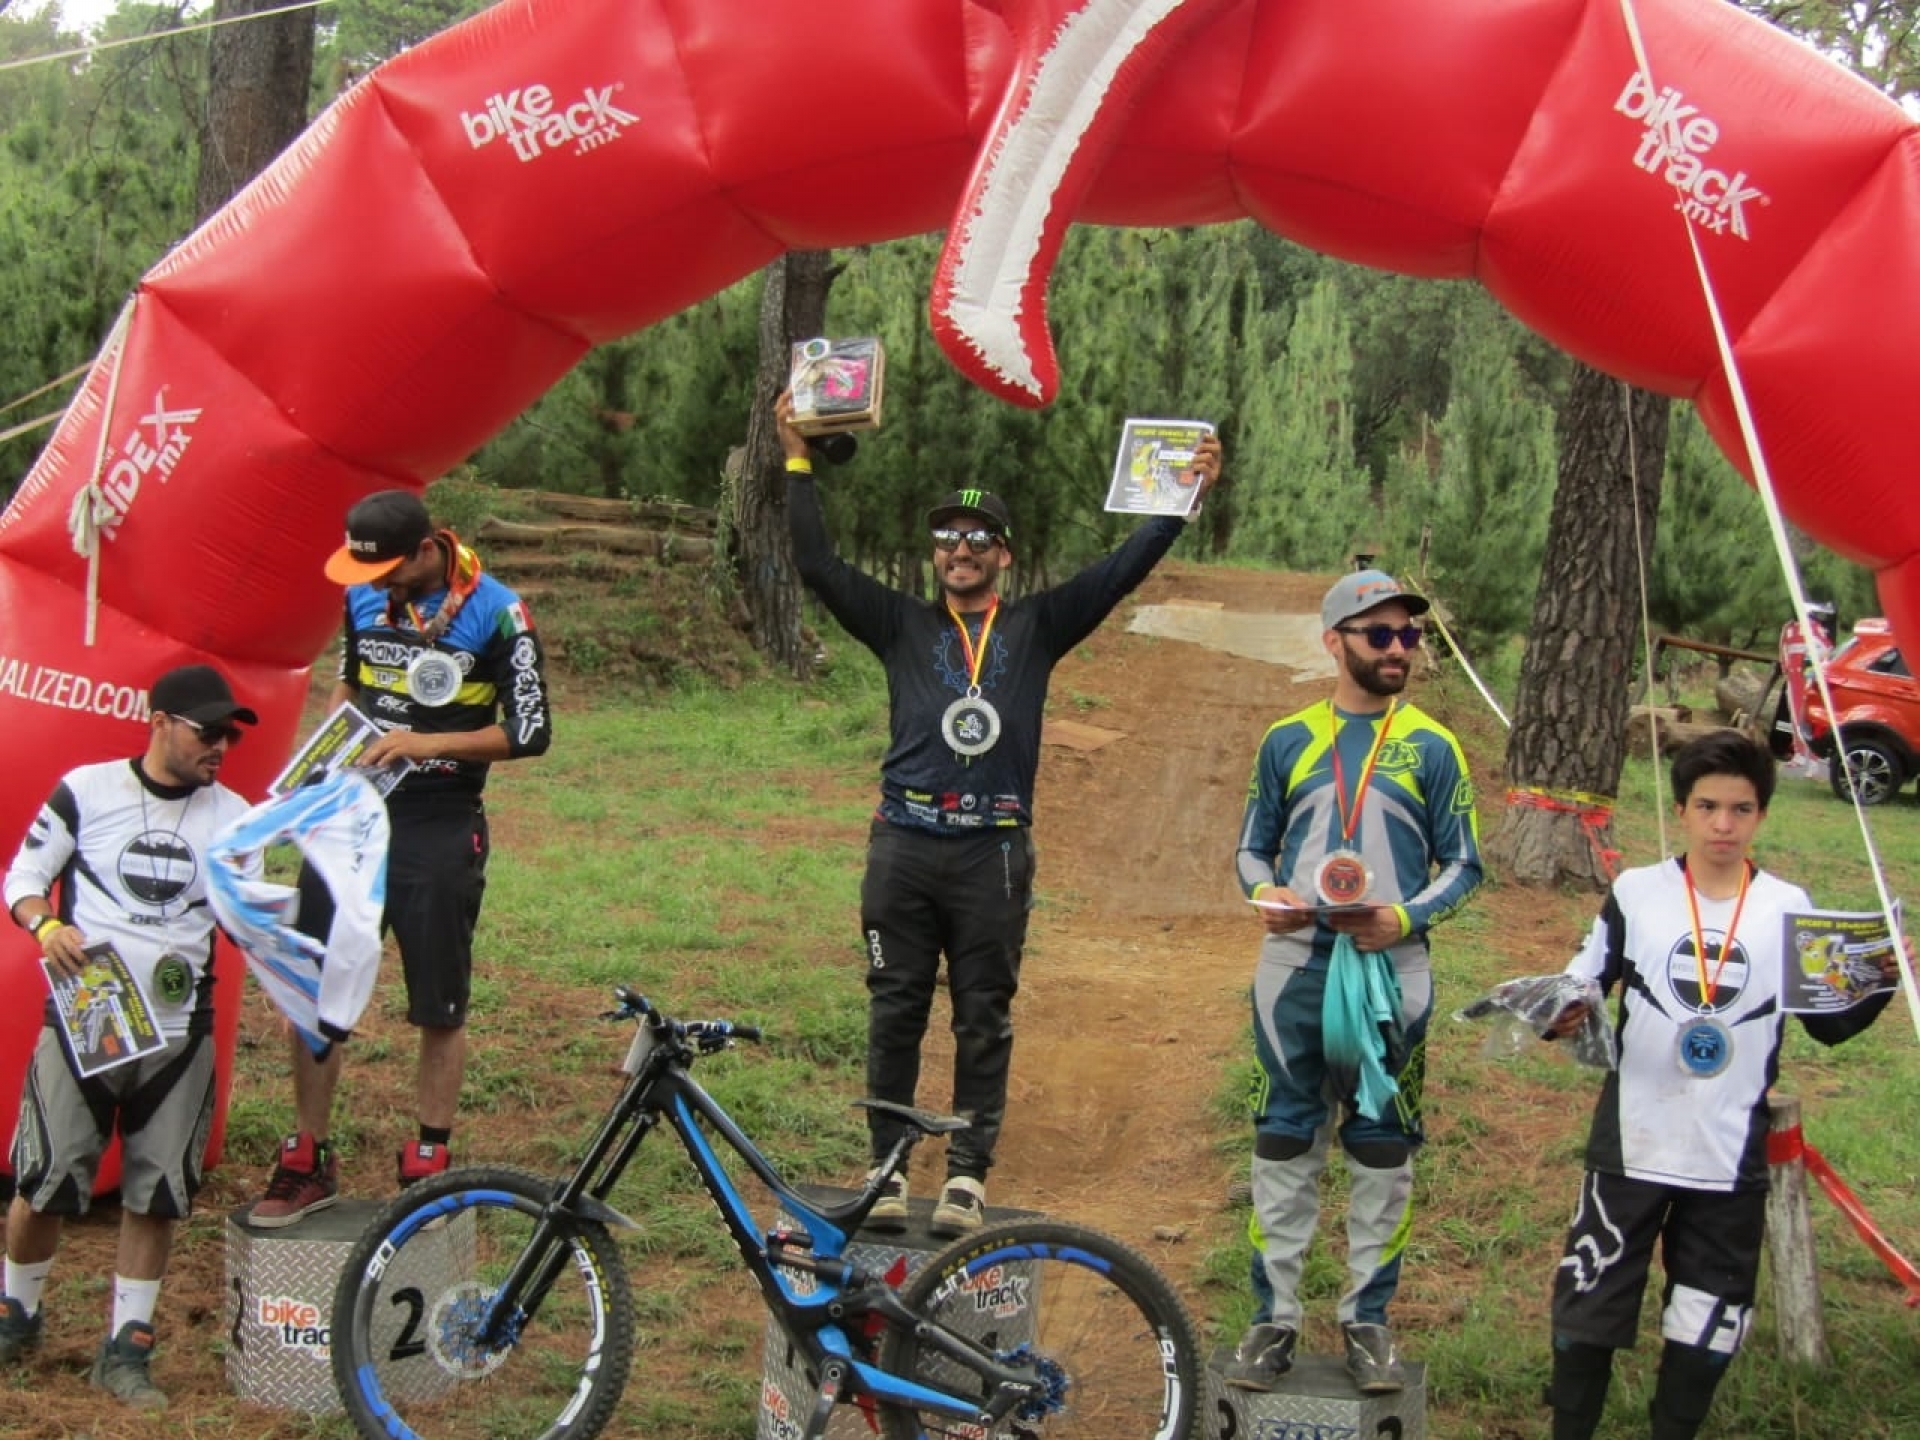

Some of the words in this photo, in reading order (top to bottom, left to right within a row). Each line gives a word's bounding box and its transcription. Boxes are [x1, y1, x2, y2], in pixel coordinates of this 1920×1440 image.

[460, 84, 554, 150] bike
[507, 86, 640, 162] track
[574, 122, 622, 156] .mx
[1614, 72, 1719, 153] bike
[1632, 130, 1763, 240] track
[262, 1299, 317, 1327] bike
[390, 1286, 427, 1362] 2
[976, 1278, 1026, 1309] track
[284, 1321, 331, 1345] trac
